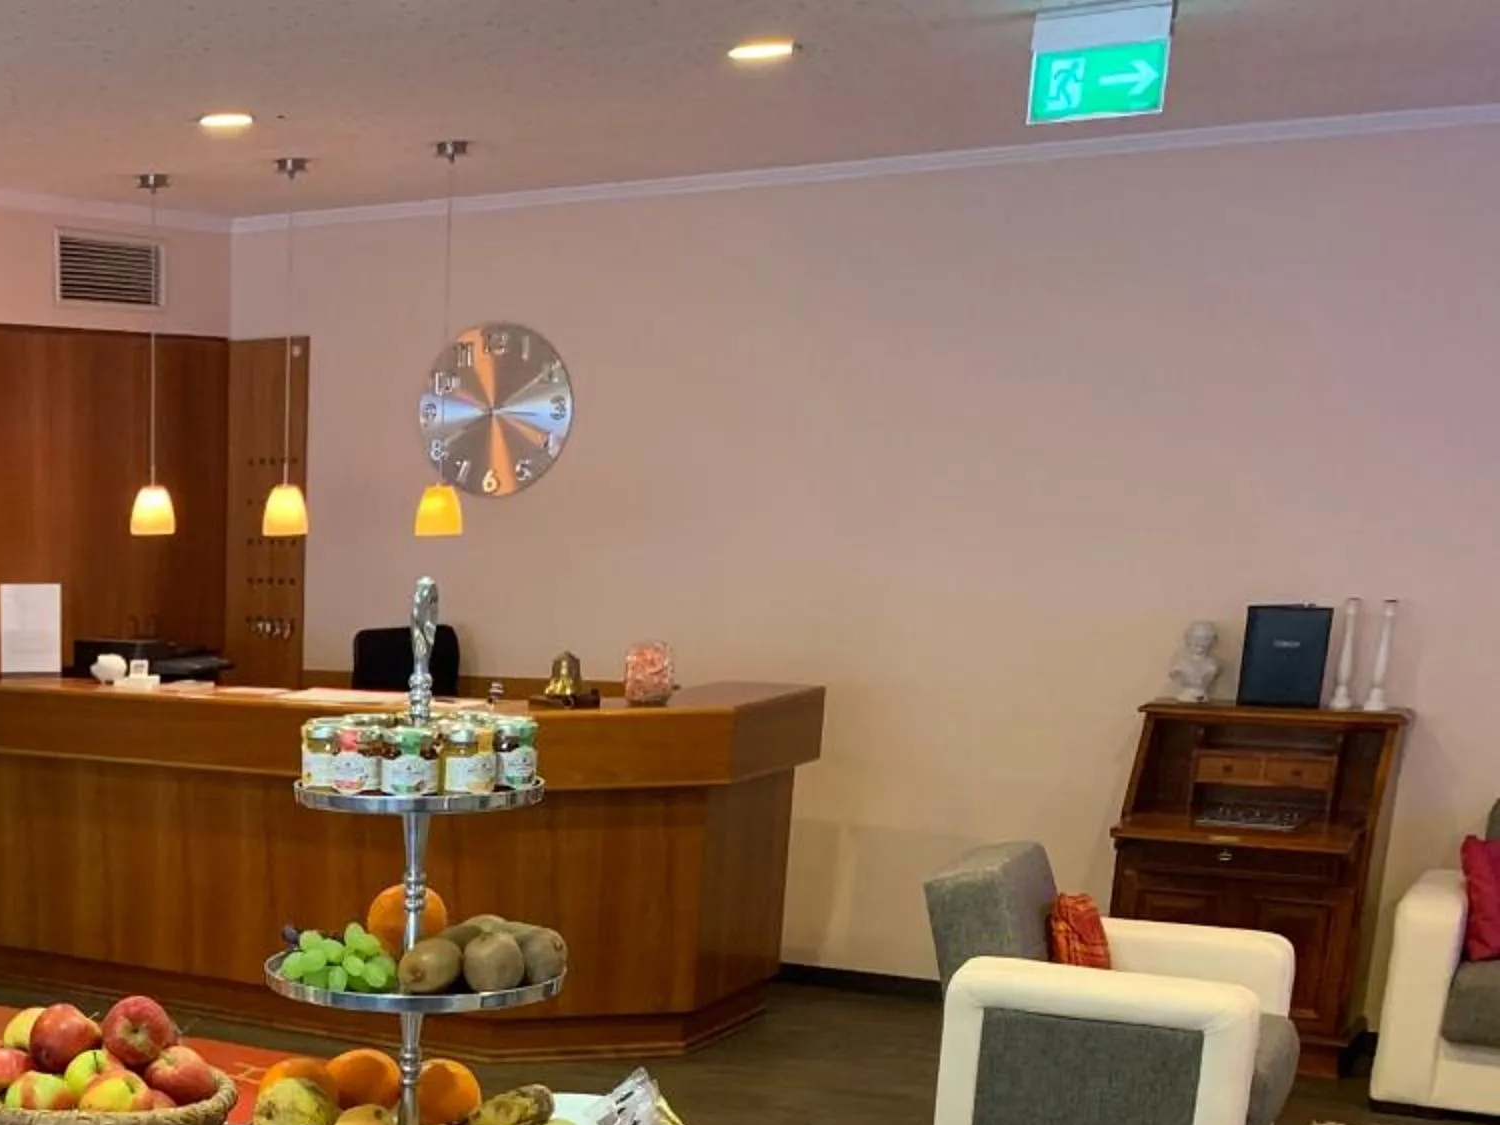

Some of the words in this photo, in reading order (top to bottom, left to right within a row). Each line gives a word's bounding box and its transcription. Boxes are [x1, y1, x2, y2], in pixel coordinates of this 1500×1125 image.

[430, 439, 446, 461] 8
[455, 459, 470, 482] 7
[482, 469, 499, 493] 6
[515, 458, 532, 481] 5
